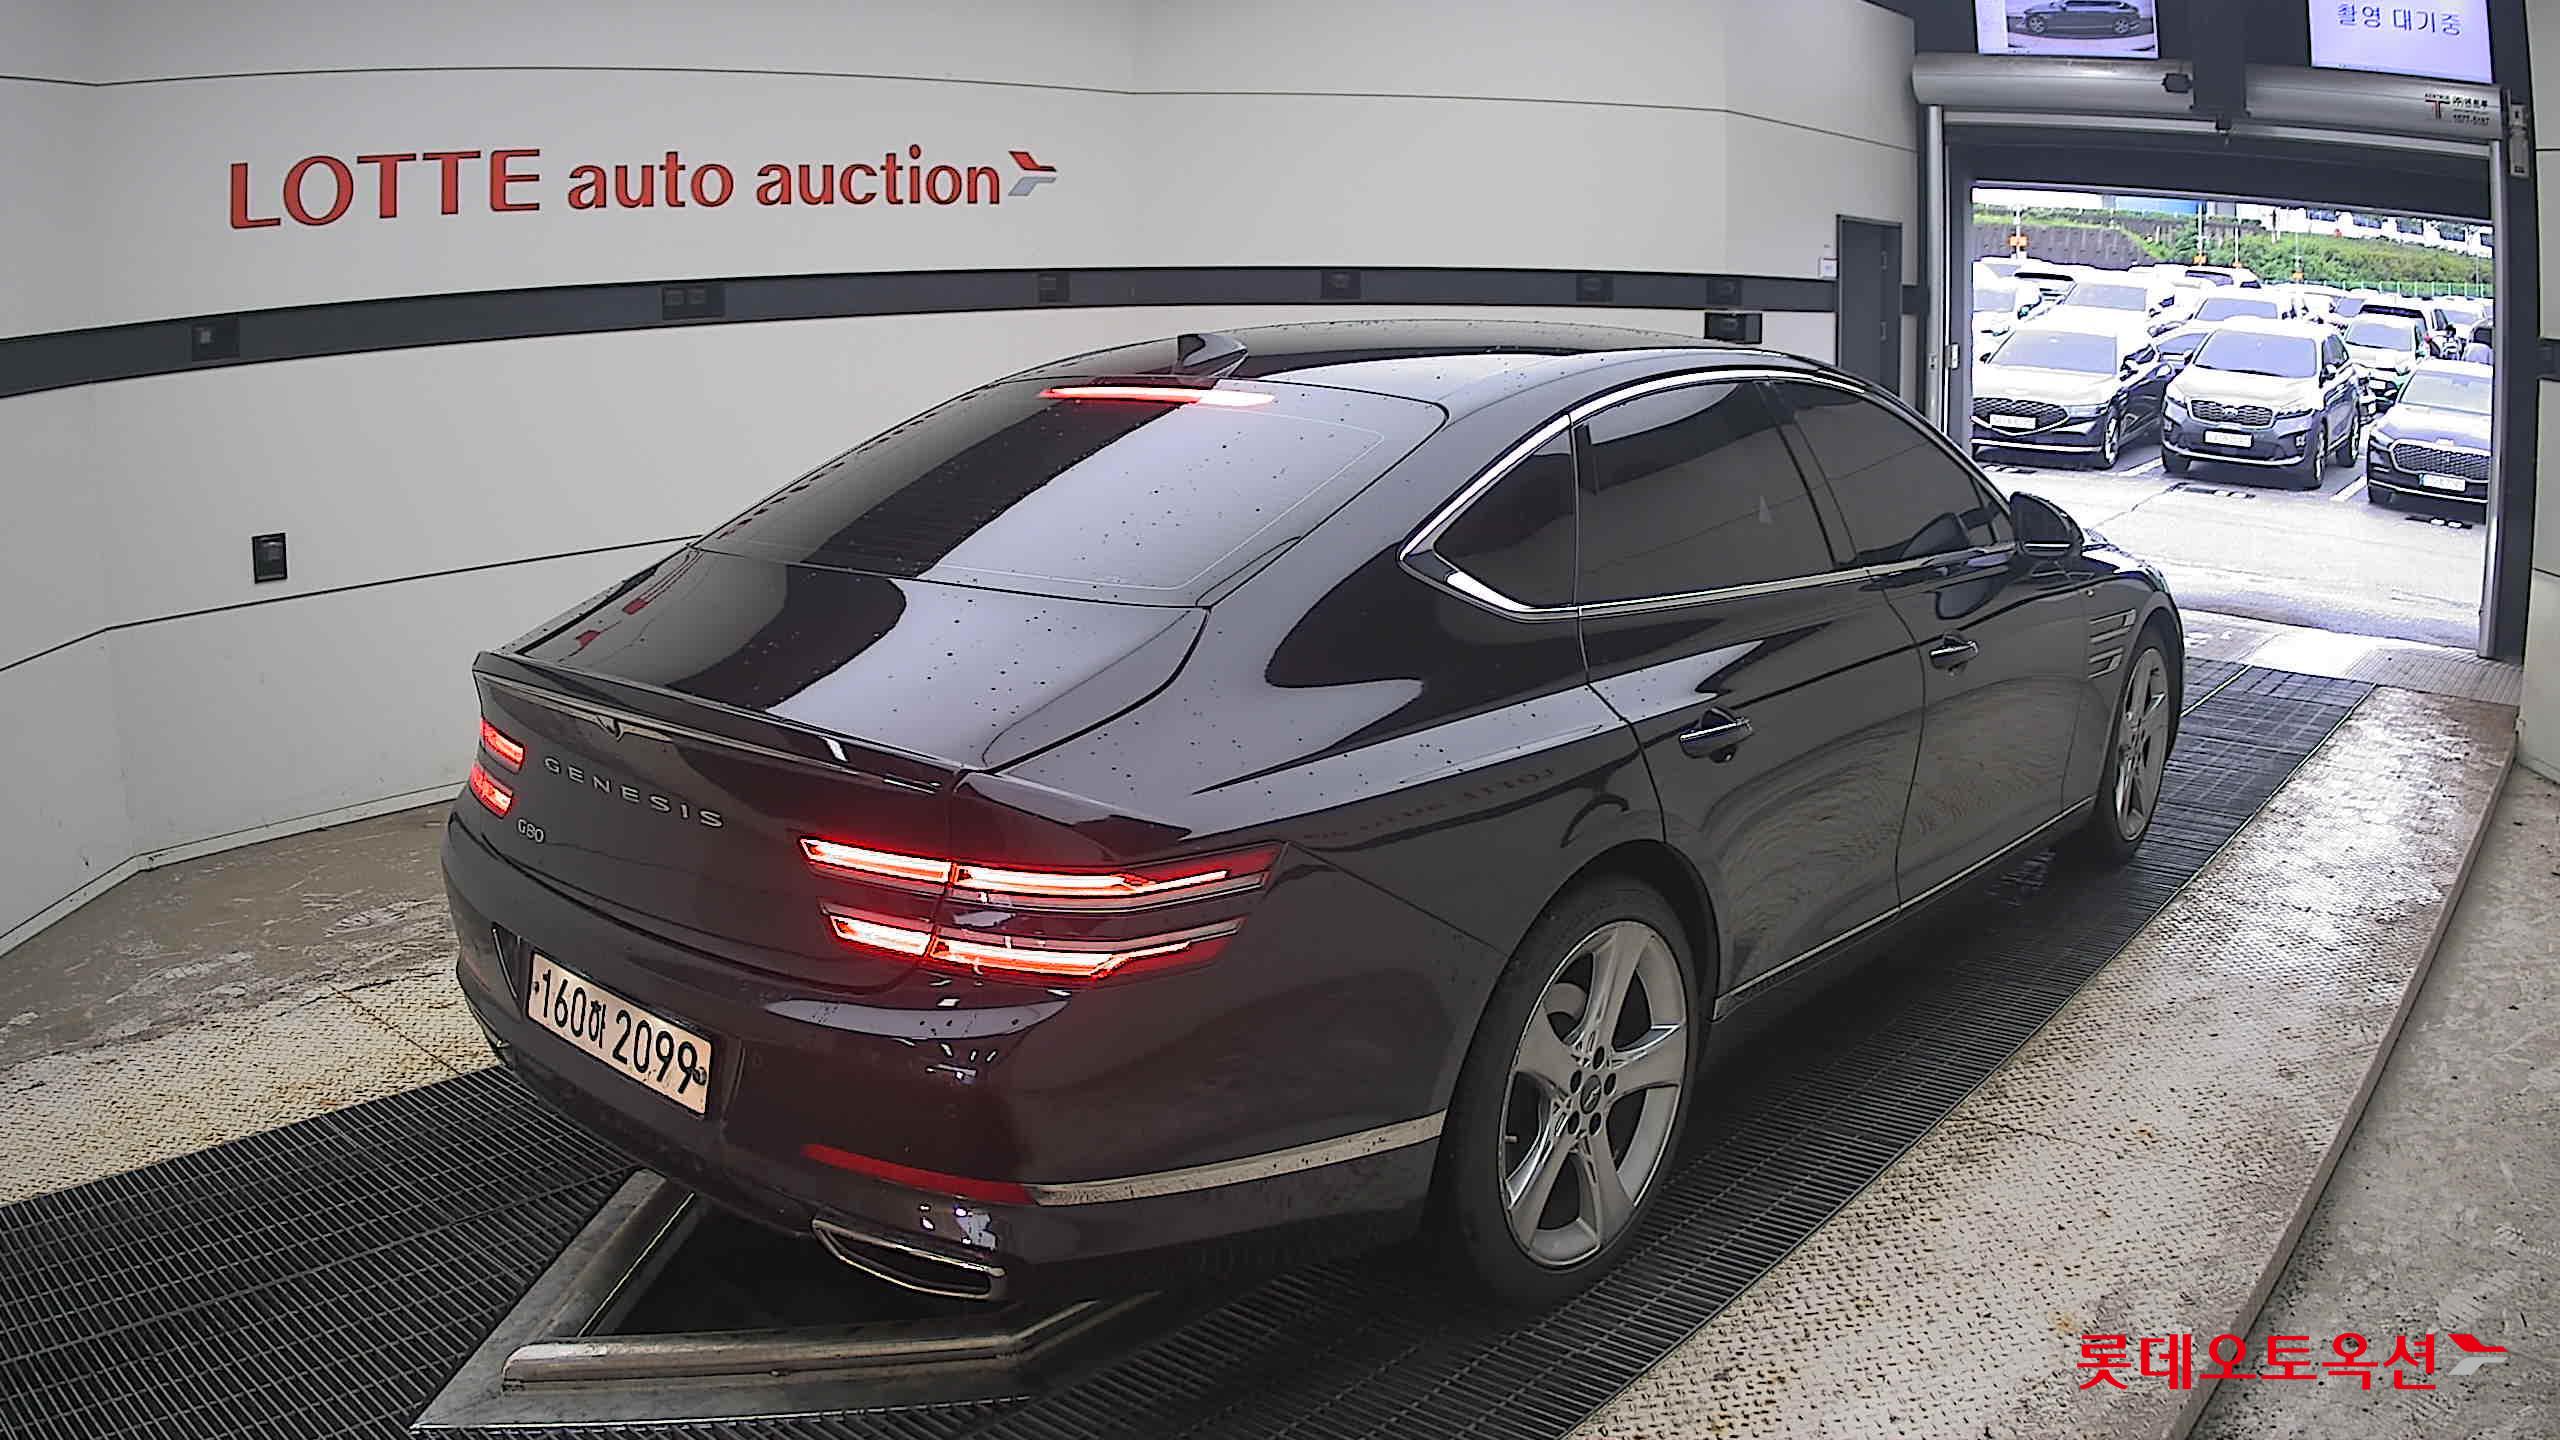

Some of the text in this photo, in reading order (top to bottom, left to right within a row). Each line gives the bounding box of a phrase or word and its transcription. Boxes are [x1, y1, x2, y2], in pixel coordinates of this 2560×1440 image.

[2337, 3, 2461, 35] 촬영 대기중
[231, 144, 1002, 229] LOTTE auto auction
[544, 757, 723, 828] GENESIS
[517, 818, 545, 843] G80
[542, 969, 698, 1094] 160하 2099
